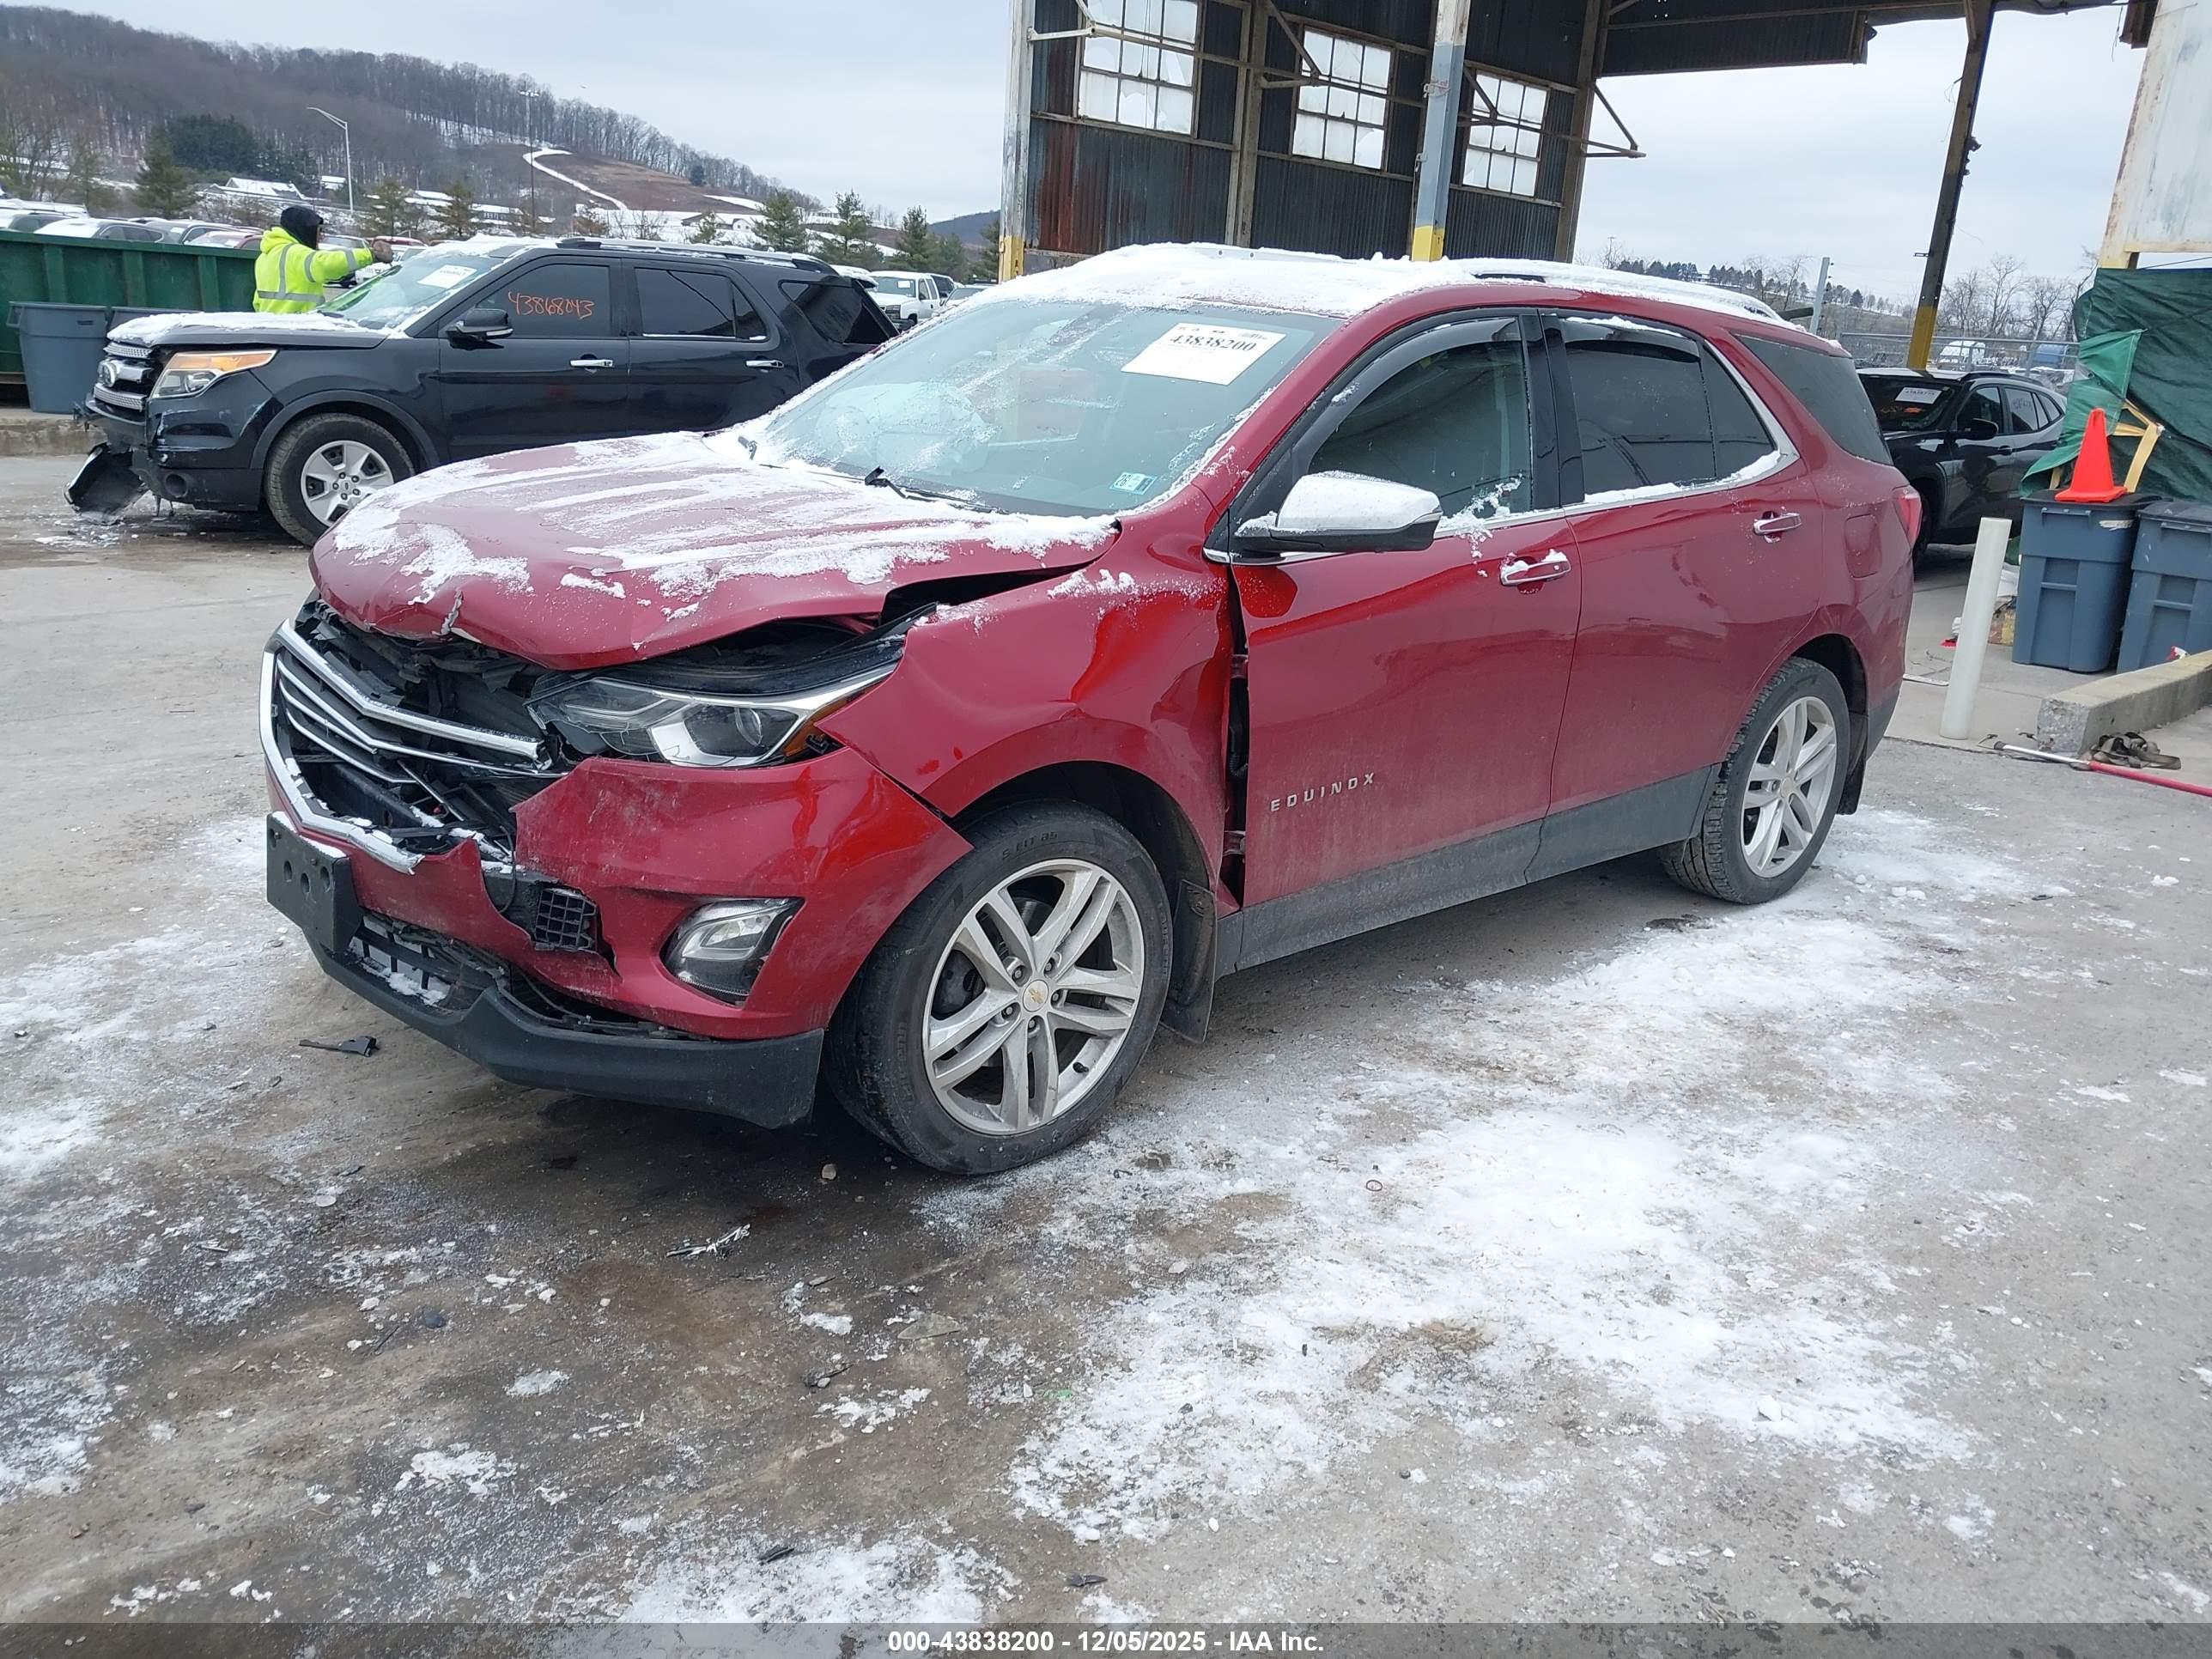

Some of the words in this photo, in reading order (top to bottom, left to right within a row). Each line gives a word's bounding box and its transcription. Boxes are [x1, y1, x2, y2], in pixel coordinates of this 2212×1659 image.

[507, 291, 595, 320] 43868043
[1170, 334, 1257, 351] 43838200
[1269, 772, 1375, 812] EQUINOX
